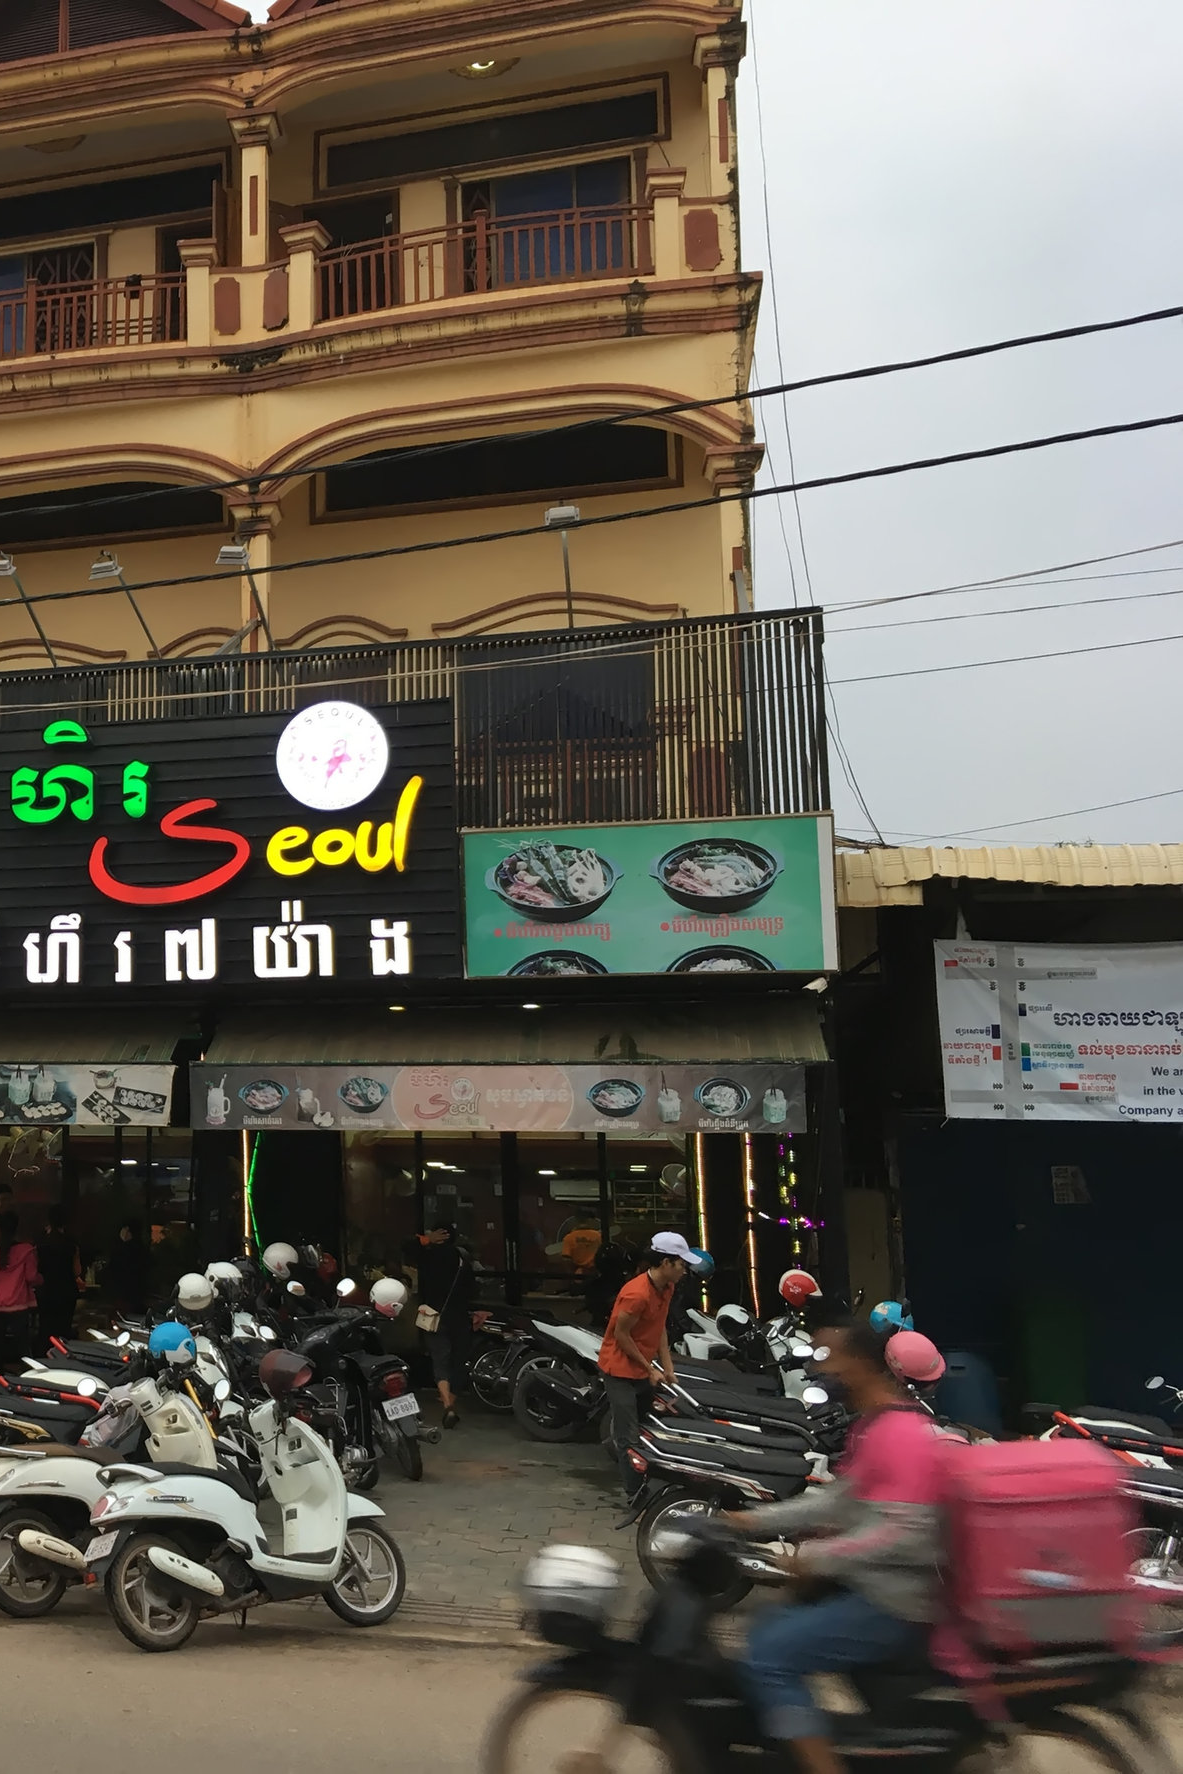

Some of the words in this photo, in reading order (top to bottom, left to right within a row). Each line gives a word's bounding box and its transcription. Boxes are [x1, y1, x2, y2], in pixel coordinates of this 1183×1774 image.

[304, 707, 364, 726] SEOUL
[88, 776, 423, 905] Seoul
[1151, 1067, 1170, 1077] We
[1143, 1086, 1154, 1095] in
[1157, 1086, 1176, 1096] the
[1118, 1104, 1174, 1117] Company
